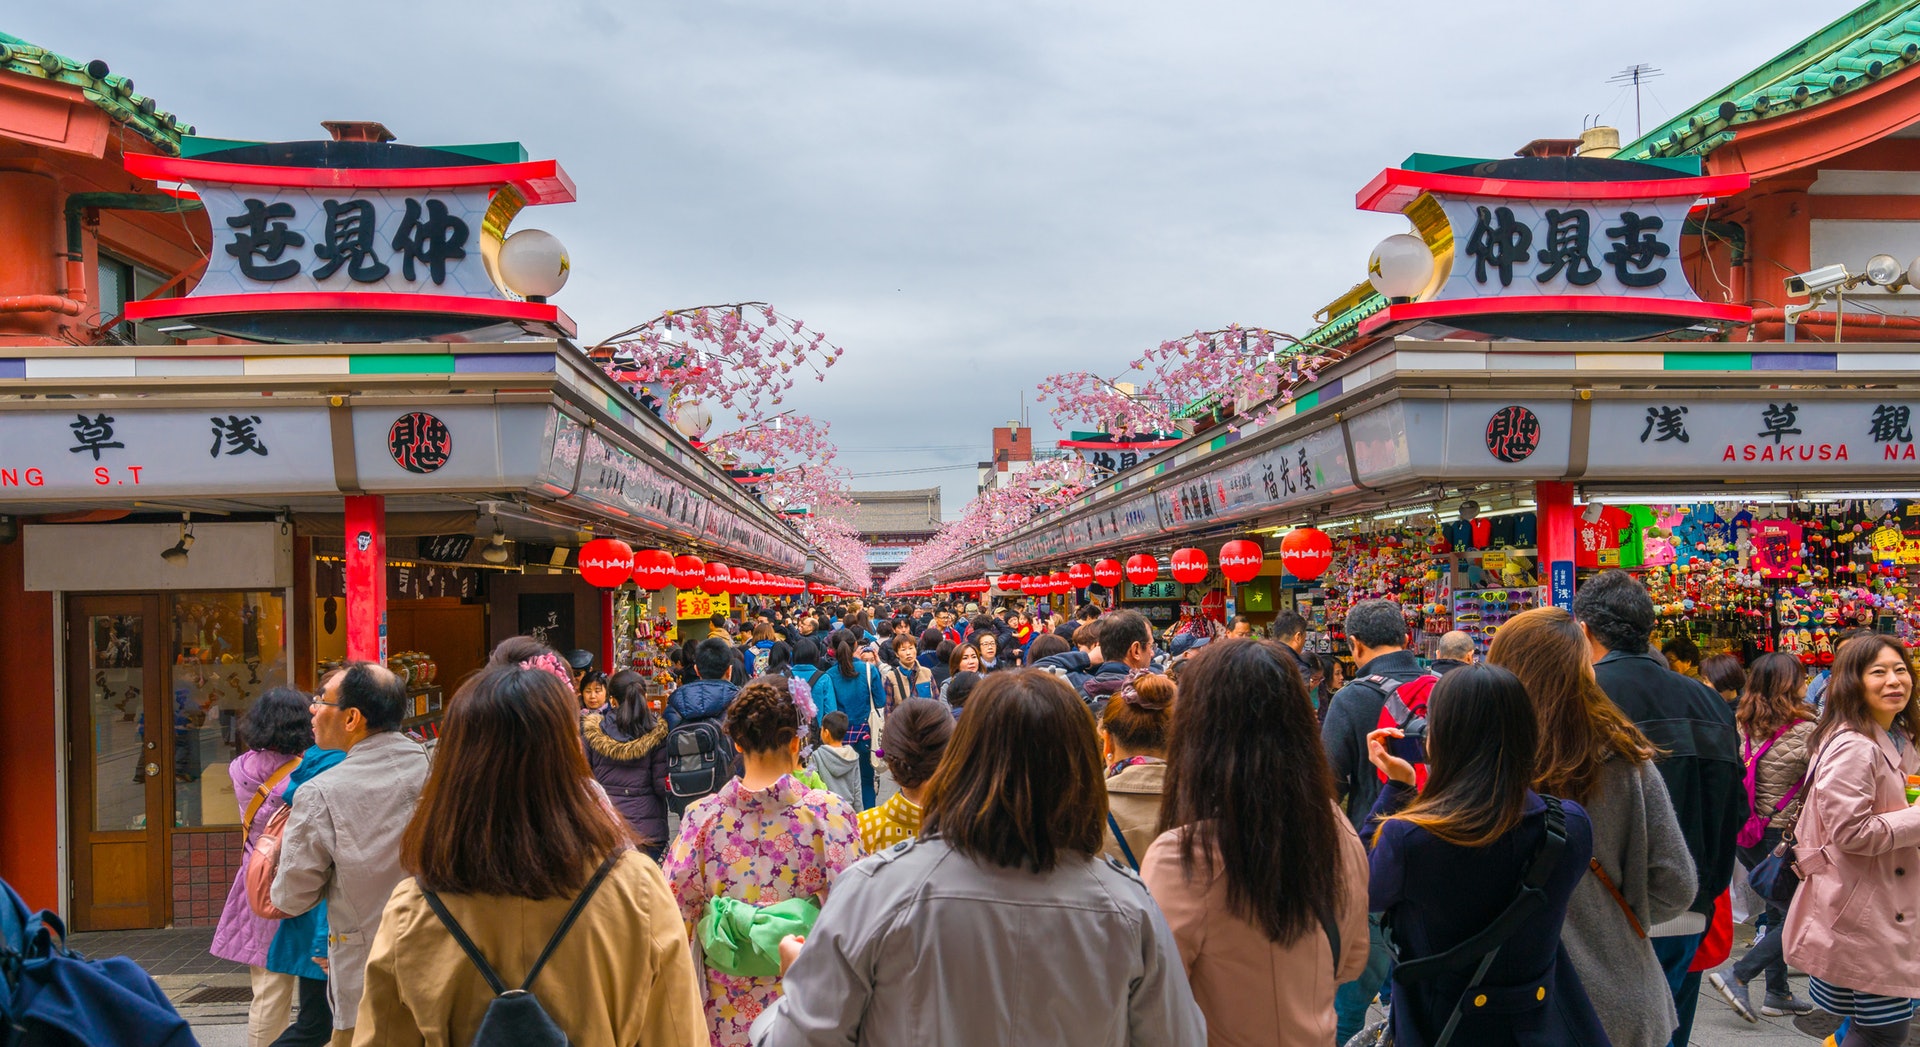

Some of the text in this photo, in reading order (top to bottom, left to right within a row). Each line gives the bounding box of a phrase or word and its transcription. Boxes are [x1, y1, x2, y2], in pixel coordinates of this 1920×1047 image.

[1722, 444, 1849, 462] ASAKUSA
[1, 465, 144, 487] NG S.T
[1262, 447, 1316, 501] 福光屋
